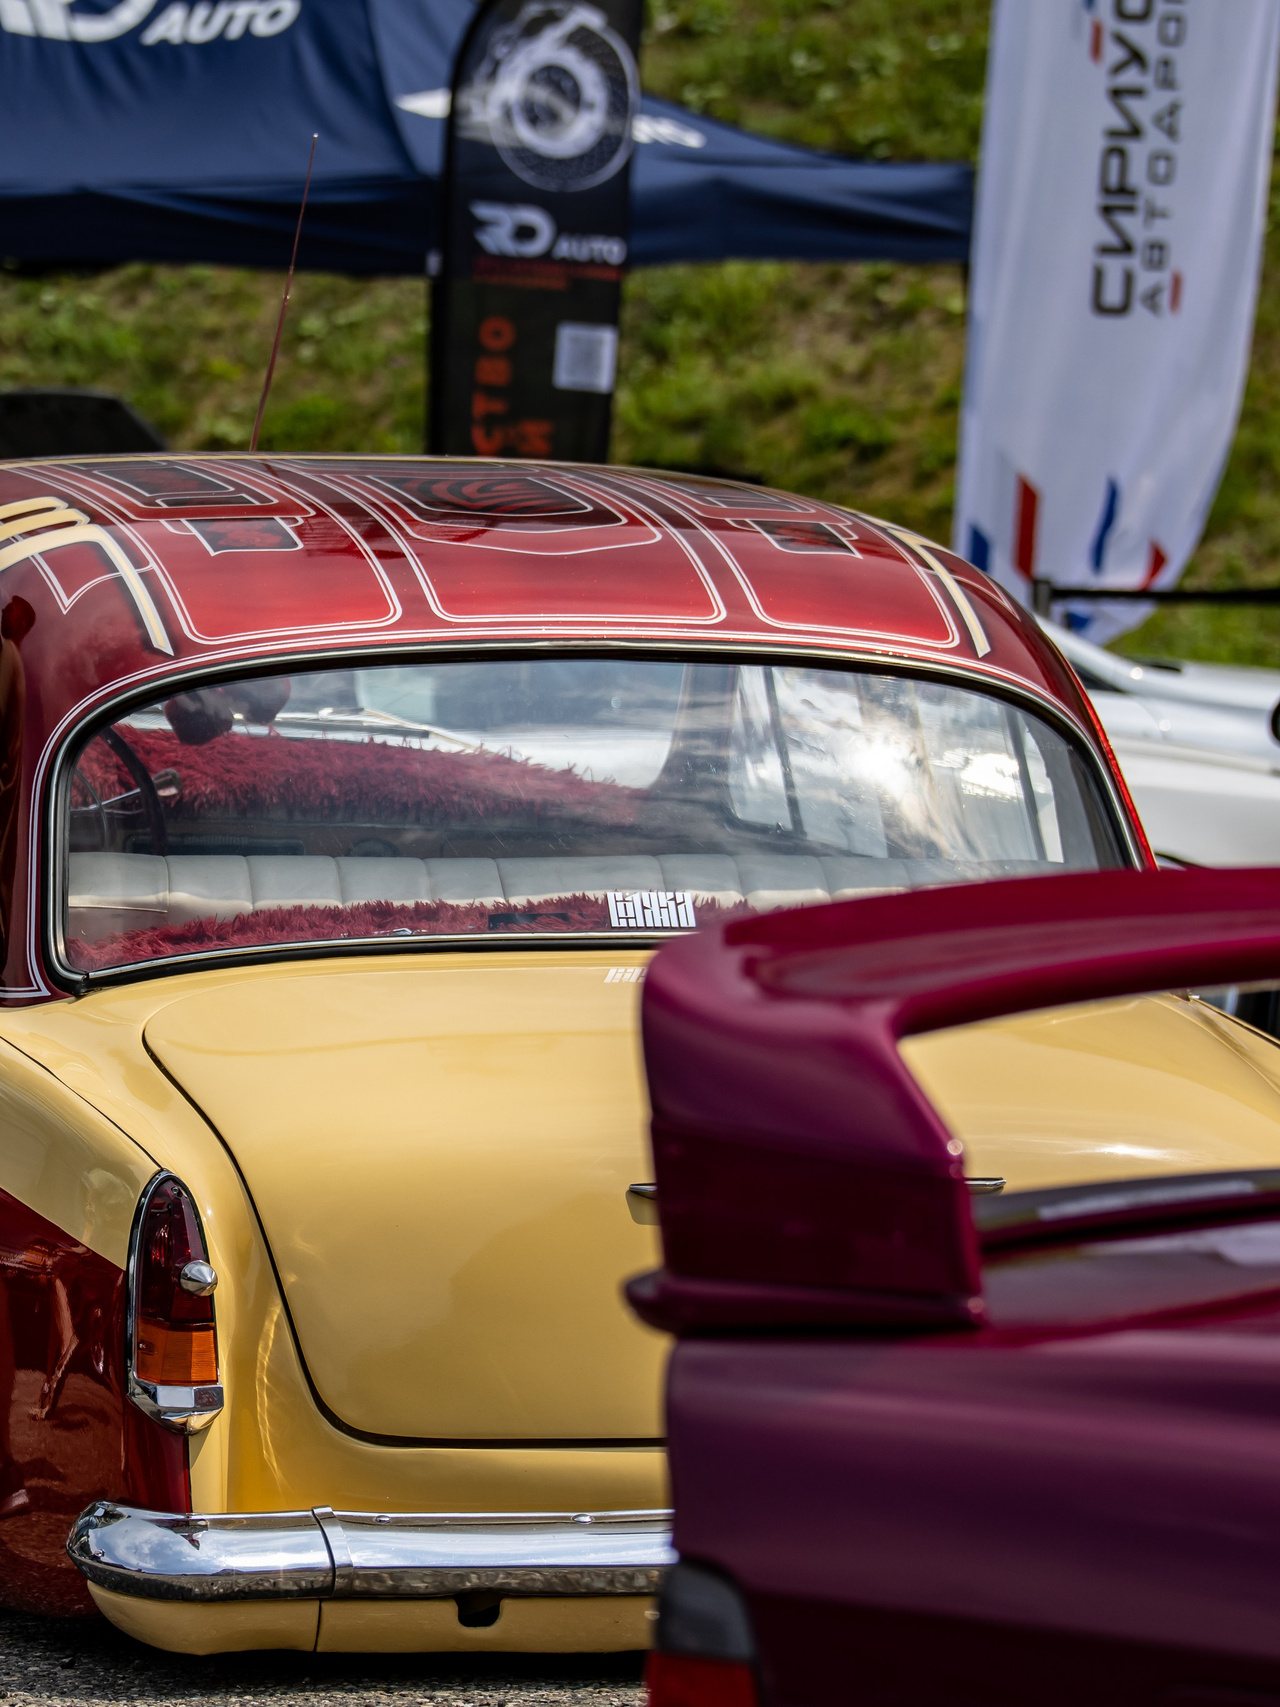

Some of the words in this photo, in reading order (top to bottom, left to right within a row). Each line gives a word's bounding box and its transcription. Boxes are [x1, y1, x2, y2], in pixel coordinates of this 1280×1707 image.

[139, 0, 301, 46] AUTO
[1139, 0, 1187, 318] АВТОДРО
[551, 234, 627, 266] AUTO
